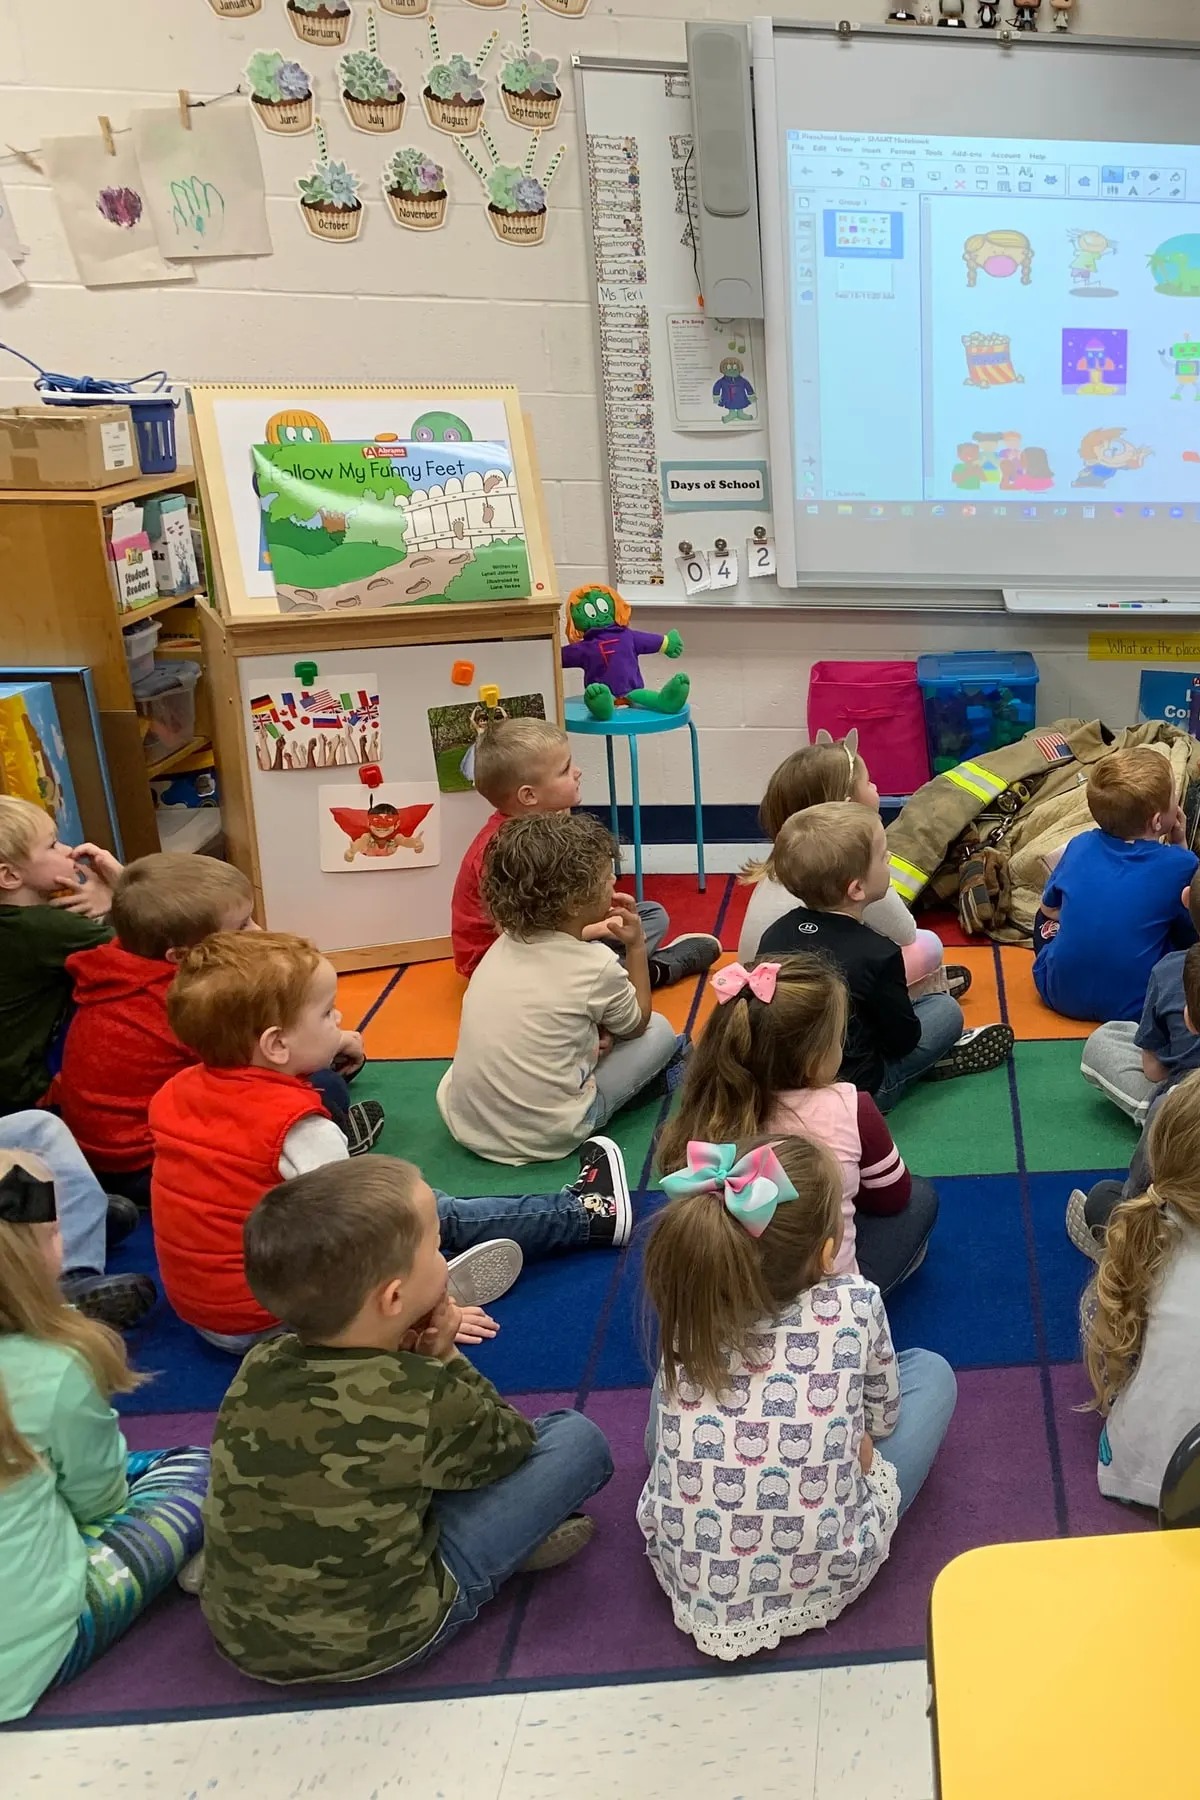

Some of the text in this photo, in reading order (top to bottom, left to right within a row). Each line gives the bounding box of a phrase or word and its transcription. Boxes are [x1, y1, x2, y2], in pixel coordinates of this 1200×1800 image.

[302, 25, 341, 41] February
[511, 104, 552, 120] September
[279, 114, 299, 125] June
[368, 114, 384, 127] July
[441, 113, 469, 130] August
[595, 141, 621, 150] Arrival
[951, 150, 983, 158] Add-ons
[1029, 153, 1046, 161] Help
[400, 208, 438, 219] November
[598, 212, 626, 220] Stations
[318, 219, 350, 231] October
[502, 224, 538, 235] December
[603, 267, 629, 275] Lunch
[600, 286, 617, 302] Ms
[611, 384, 633, 393] Movie
[611, 405, 638, 414] Literacy
[613, 431, 640, 440] Recess
[270, 460, 465, 483] Follow My Funny Feet
[617, 481, 641, 491] Snack
[670, 480, 761, 491] Days of School
[620, 501, 650, 511] Pack up
[621, 518, 638, 527] Read
[623, 544, 650, 554] Closing
[756, 547, 770, 567] 2
[623, 567, 653, 575] Go Home
[687, 562, 703, 582] 0
[717, 560, 731, 579] 4
[124, 567, 150, 585] Student
[126, 580, 151, 596] Readers
[1105, 637, 1137, 655] What
[1139, 645, 1153, 654] are
[1155, 638, 1173, 655] the
[1175, 641, 1200, 658] places
